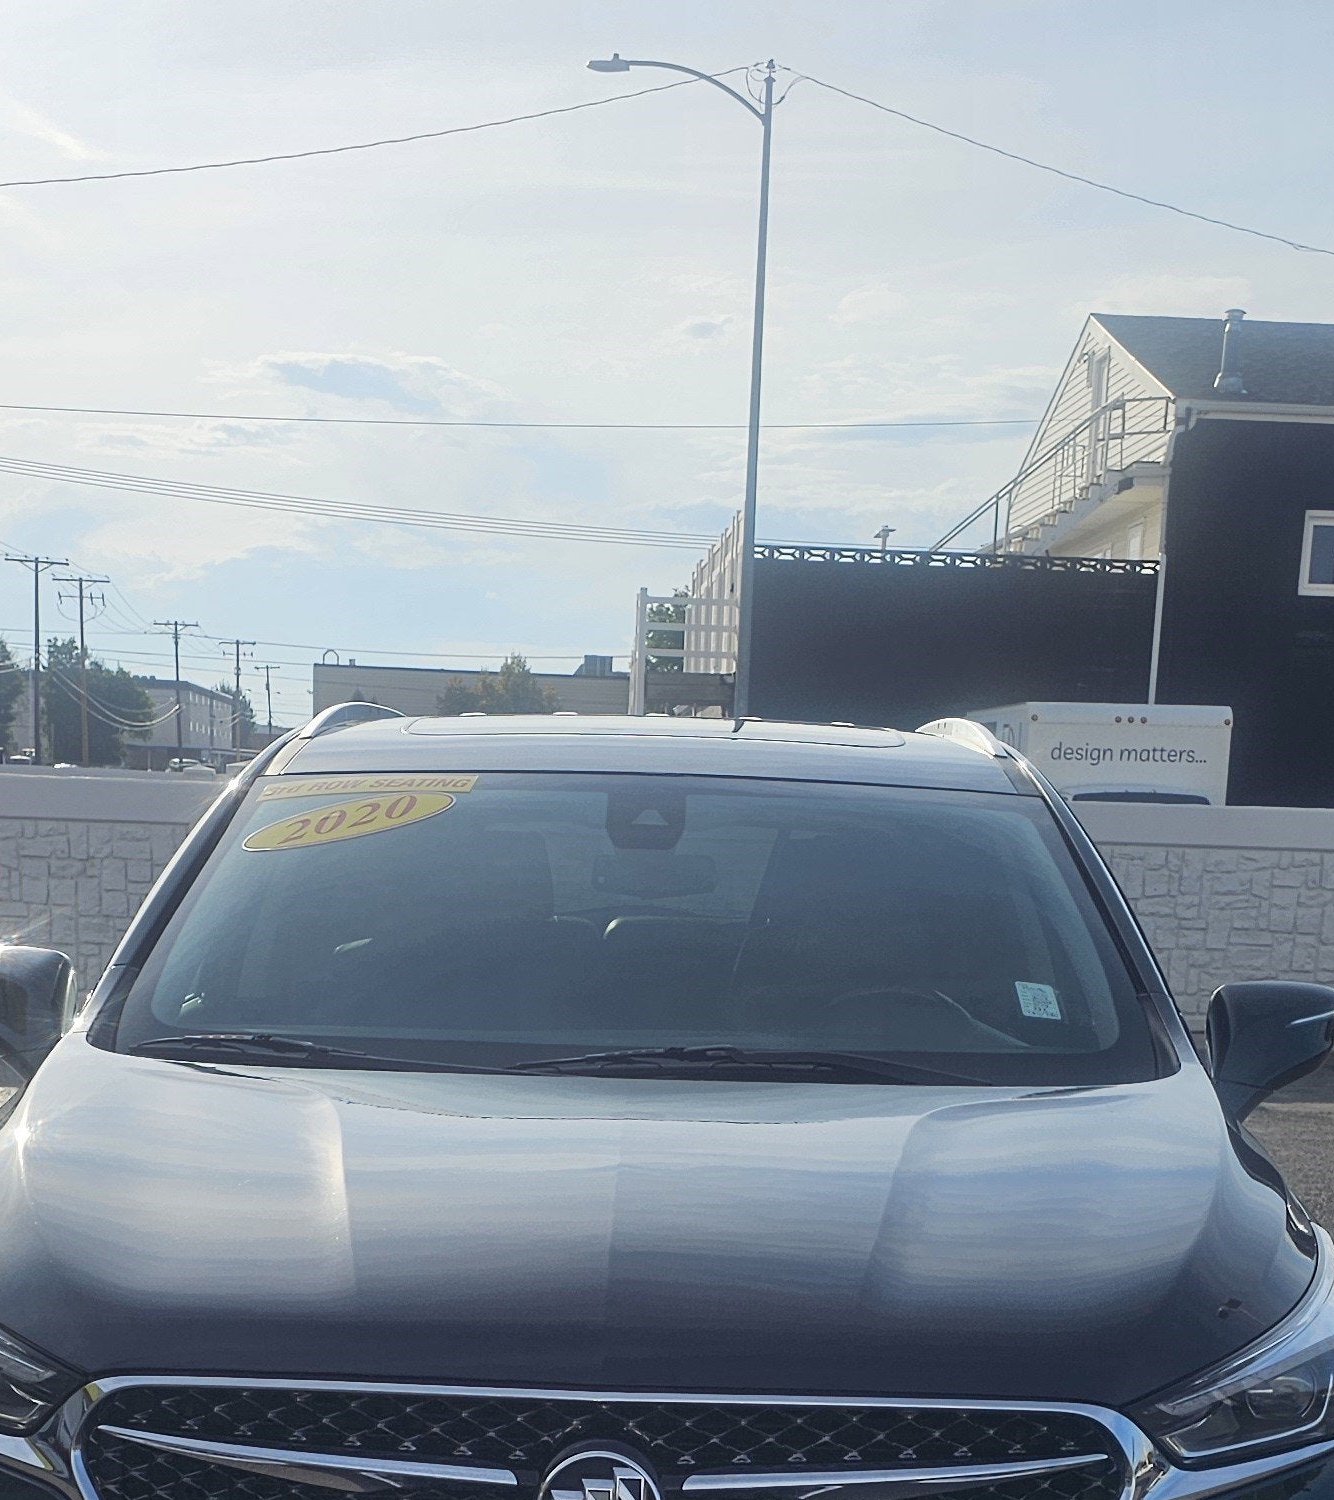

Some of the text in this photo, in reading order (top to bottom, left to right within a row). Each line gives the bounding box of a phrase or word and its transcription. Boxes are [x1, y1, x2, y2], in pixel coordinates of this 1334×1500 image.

[1050, 741, 1207, 766] design matters...
[307, 779, 368, 792] ROW
[369, 776, 472, 789] SEATING
[276, 794, 418, 845] 2020
